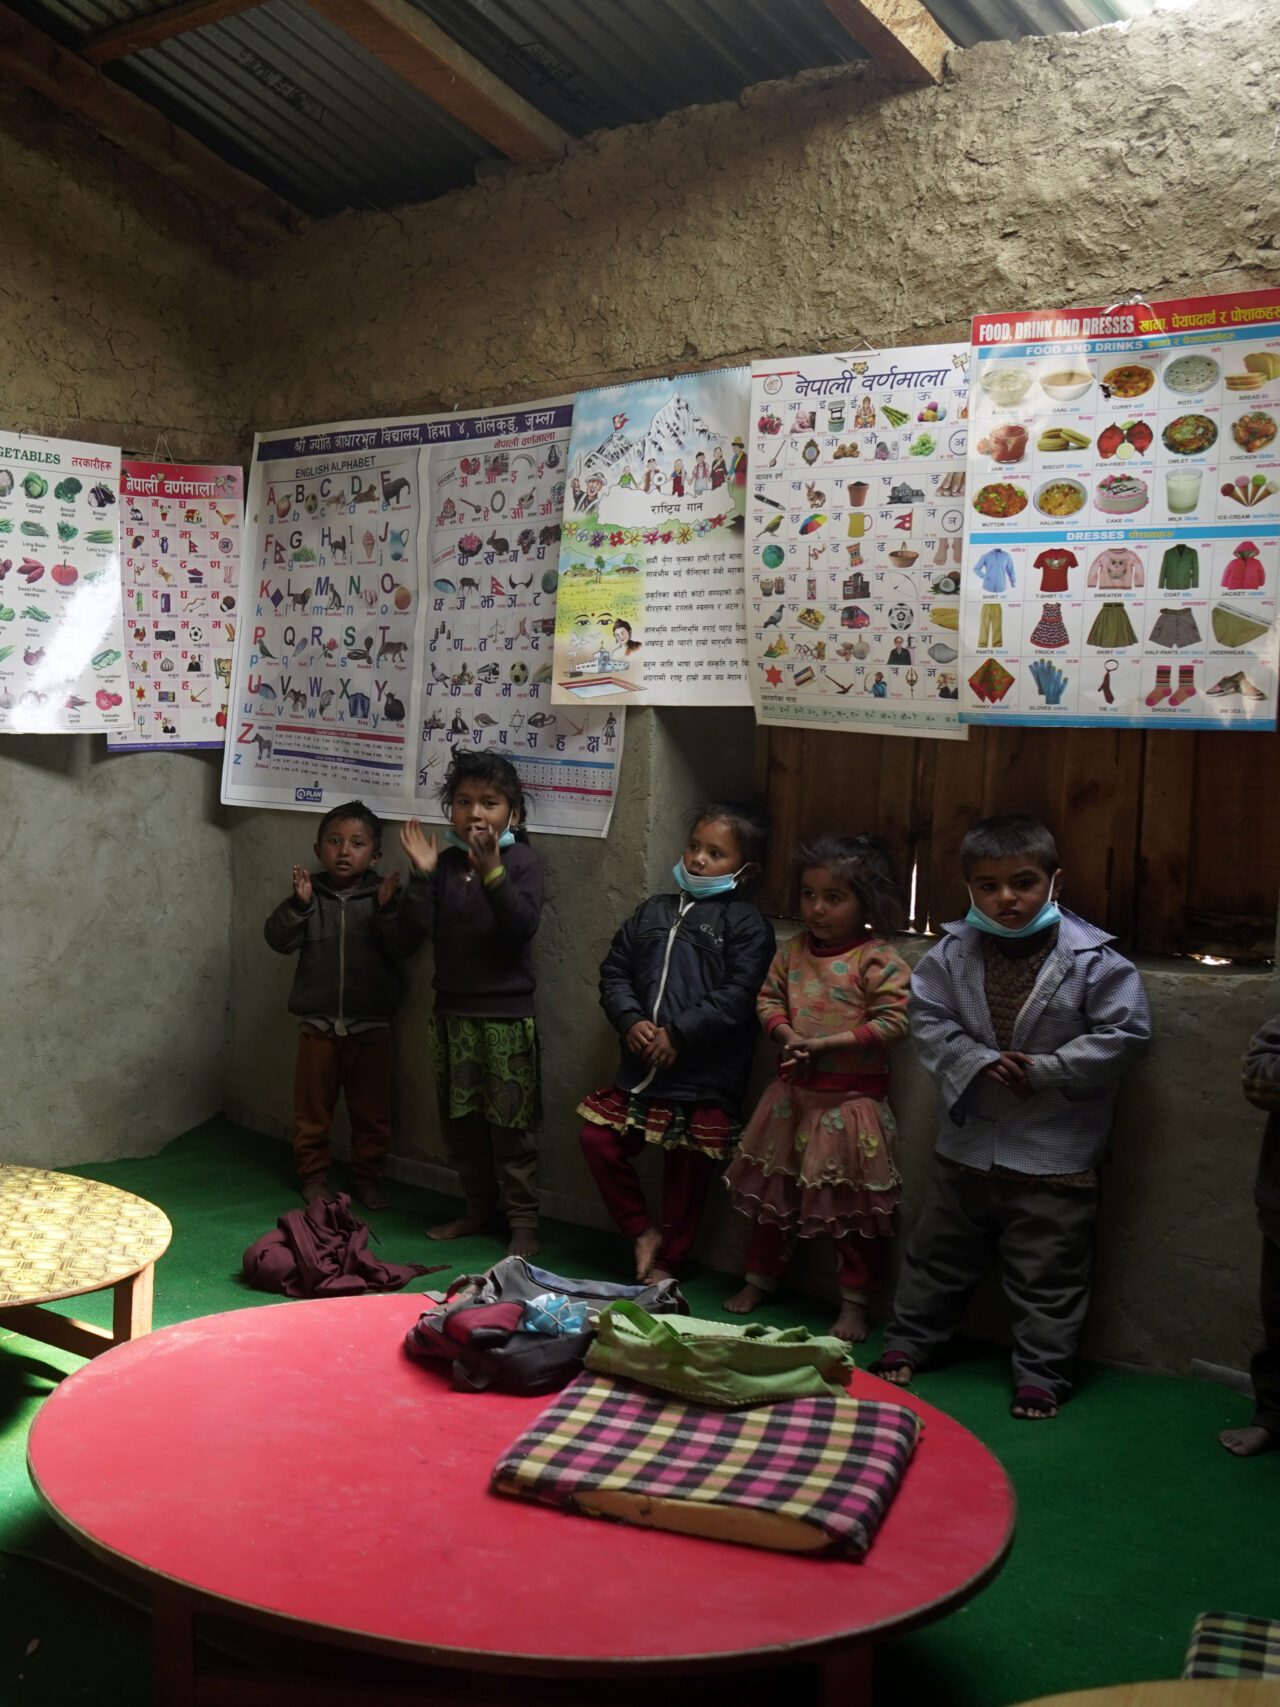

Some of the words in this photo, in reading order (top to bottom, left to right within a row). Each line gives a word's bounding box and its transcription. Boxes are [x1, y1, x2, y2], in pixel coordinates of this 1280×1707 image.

[979, 322, 1013, 343] FOOD,
[1014, 319, 1053, 340] DRINK
[1054, 318, 1081, 338] AND
[1081, 314, 1135, 337] DRESSES
[1171, 309, 1217, 328] पेयपदार्थ
[1219, 311, 1228, 324] र
[1026, 344, 1062, 356] FOOD
[1064, 343, 1093, 354] AND
[1095, 340, 1144, 352] DRINKS
[795, 369, 858, 397] नेपाली
[861, 365, 951, 391] वर्णमाला
[294, 437, 305, 452] श्री
[428, 423, 451, 440] हिमा
[524, 410, 556, 432] जुम्ला
[494, 436, 519, 449] नेपाली
[521, 431, 556, 446] वर्णमाला
[295, 464, 330, 479] ENGLISH
[331, 455, 377, 471] ALPHABET
[126, 473, 159, 495] नेपाली
[164, 476, 217, 497] वर्णमाला
[267, 487, 276, 506] A
[295, 484, 305, 503] B
[320, 478, 331, 497] C
[351, 475, 362, 495] D
[754, 483, 767, 493] क
[791, 481, 804, 491] ख
[834, 479, 844, 489] ग
[881, 476, 893, 486] घ
[686, 502, 703, 512] गान
[290, 530, 302, 549] G
[321, 526, 331, 547] H
[1066, 531, 1125, 541] DRESSES
[259, 579, 272, 598] K
[314, 576, 330, 596] M
[349, 575, 360, 595] N
[380, 572, 394, 594] O
[284, 626, 295, 647] Q
[311, 626, 323, 647] R
[344, 626, 356, 647] S
[339, 678, 351, 699] X
[375, 680, 388, 701] Y
[237, 723, 254, 744] Z
[305, 789, 322, 798] PLAN
